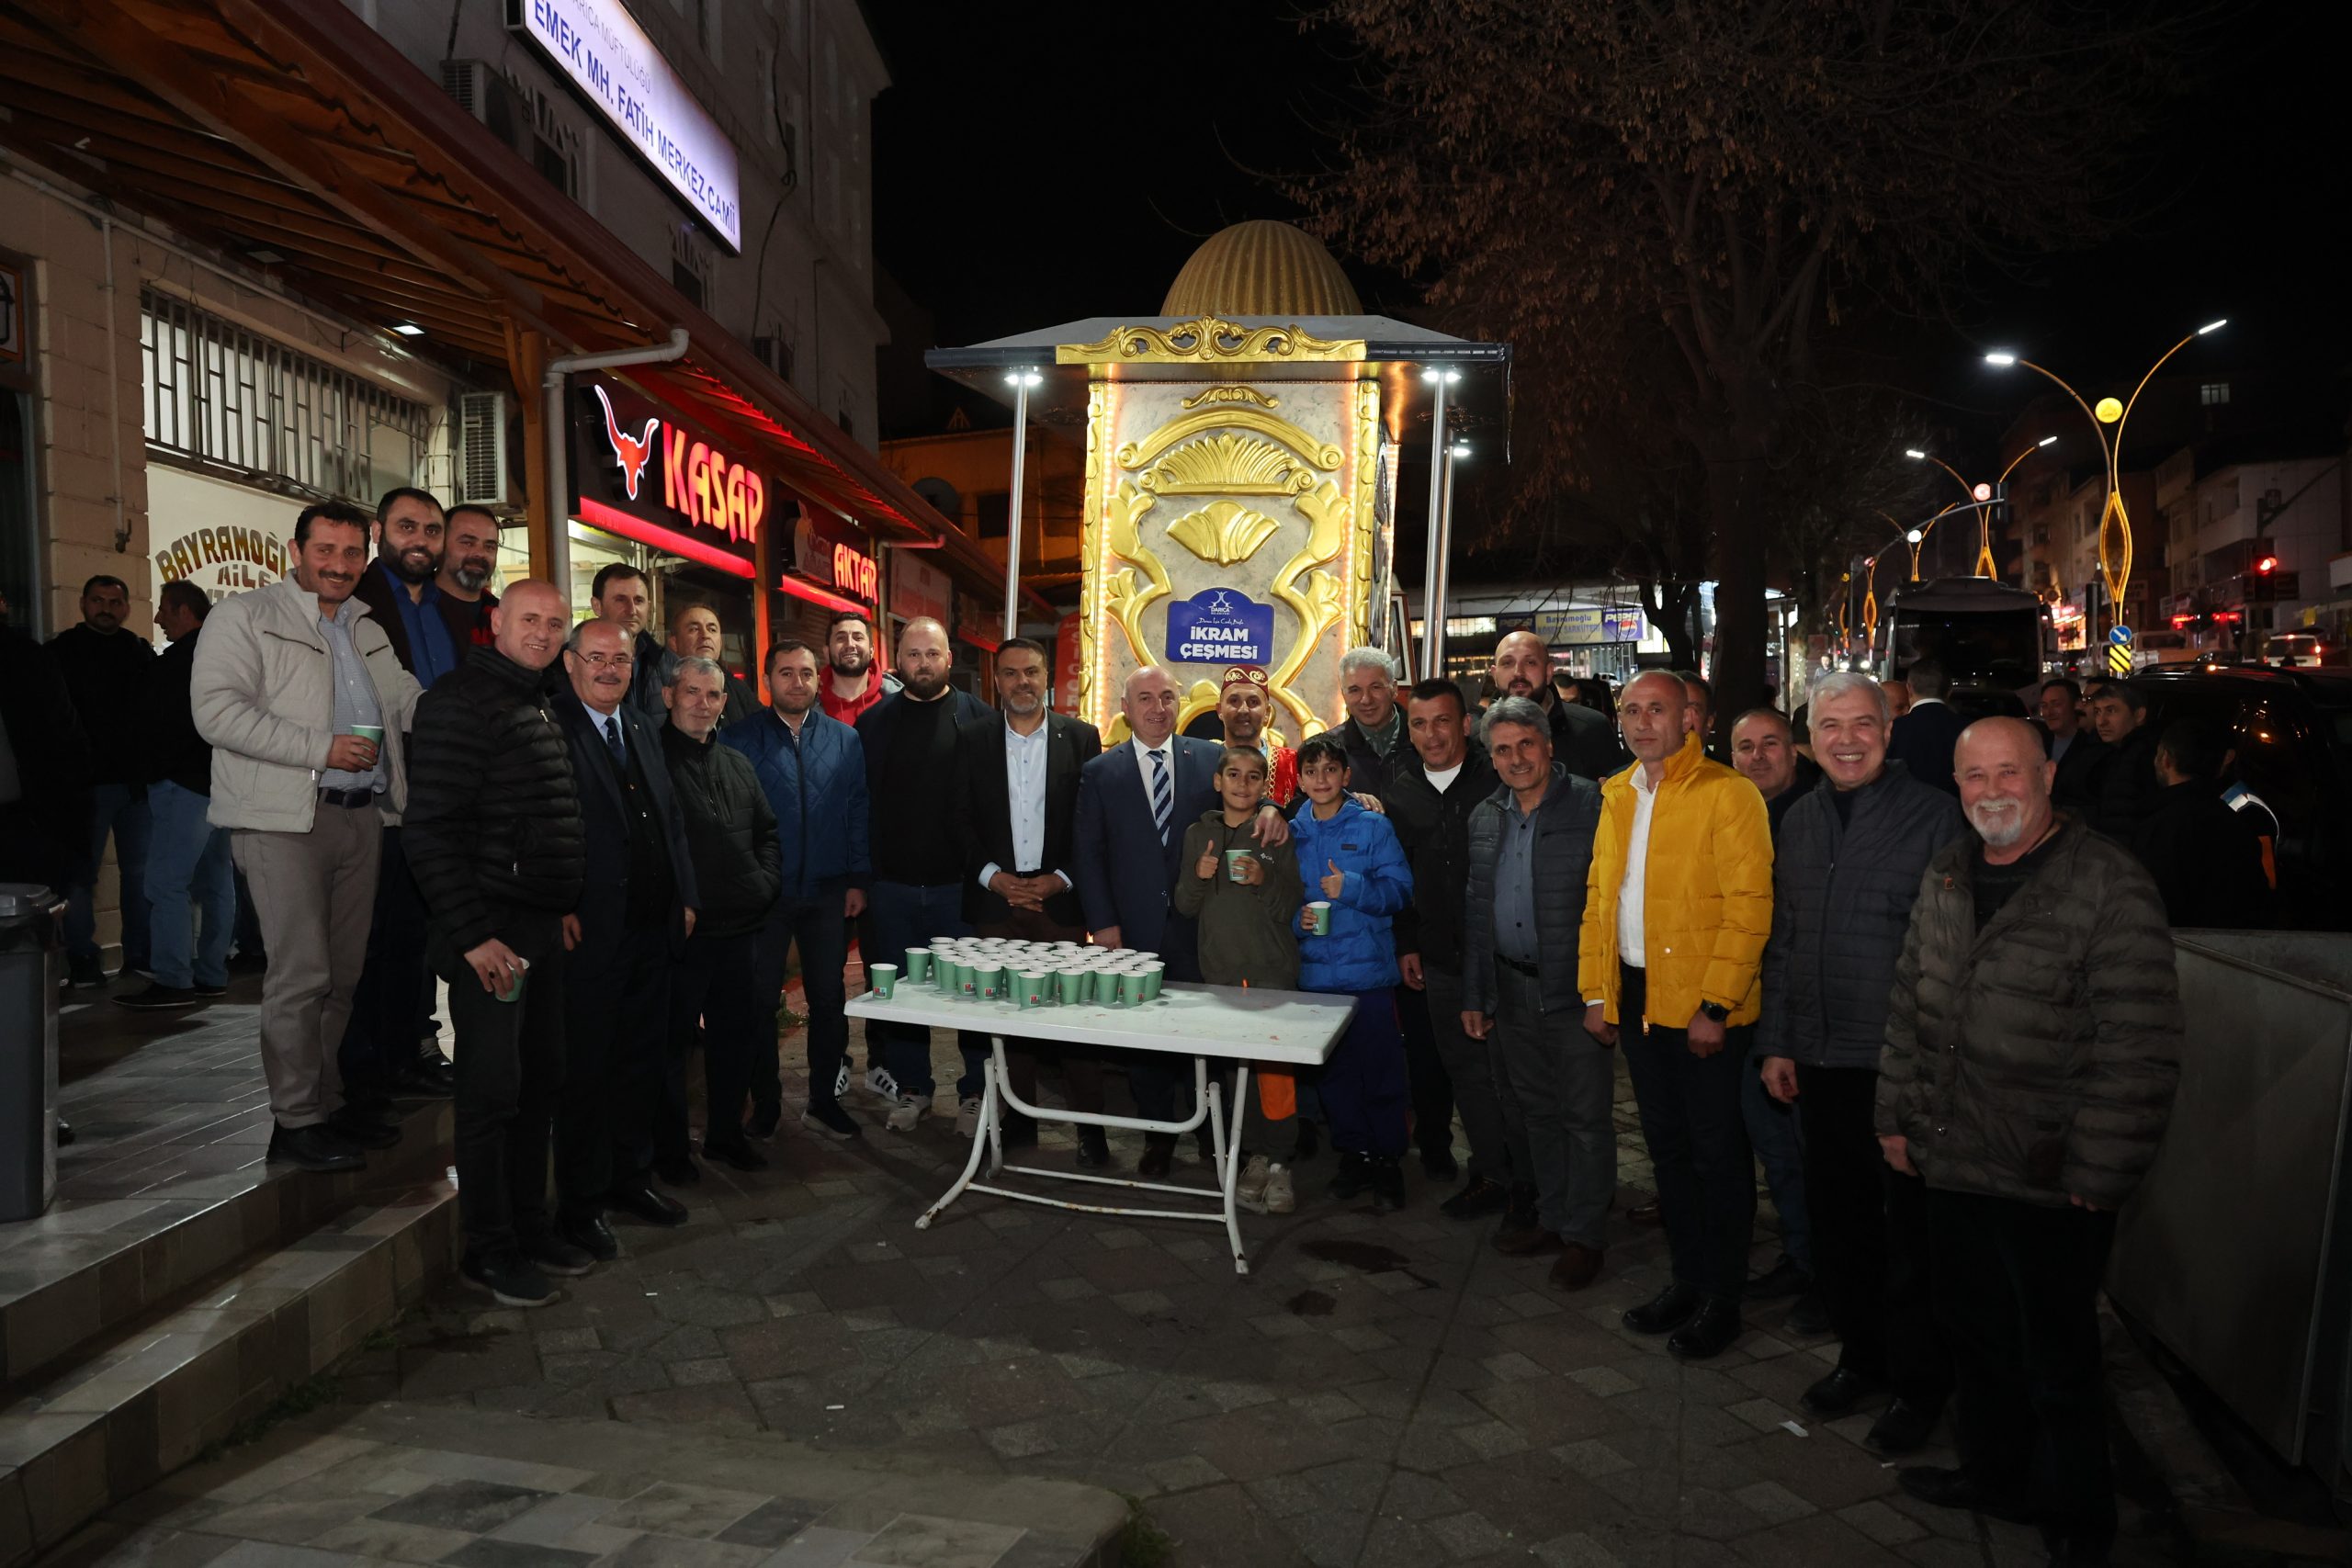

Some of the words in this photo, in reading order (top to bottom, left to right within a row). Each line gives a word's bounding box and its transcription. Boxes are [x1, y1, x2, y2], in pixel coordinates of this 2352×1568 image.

[601, 21, 651, 94] MÜFTÜLÜĞÜ
[535, 0, 582, 69] EMEK
[587, 49, 614, 105] MH.
[617, 84, 654, 147] FATİH
[657, 129, 706, 203] MERKEZ
[707, 186, 736, 235] CAMİİ
[663, 421, 763, 544] KASAP
[218, 564, 271, 589] AİLE
[833, 542, 878, 606] AKTAR
[1190, 626, 1249, 642] İKRAM
[1604, 612, 1640, 623] PEPSI
[1180, 642, 1258, 660] ÇEŞMESİ
